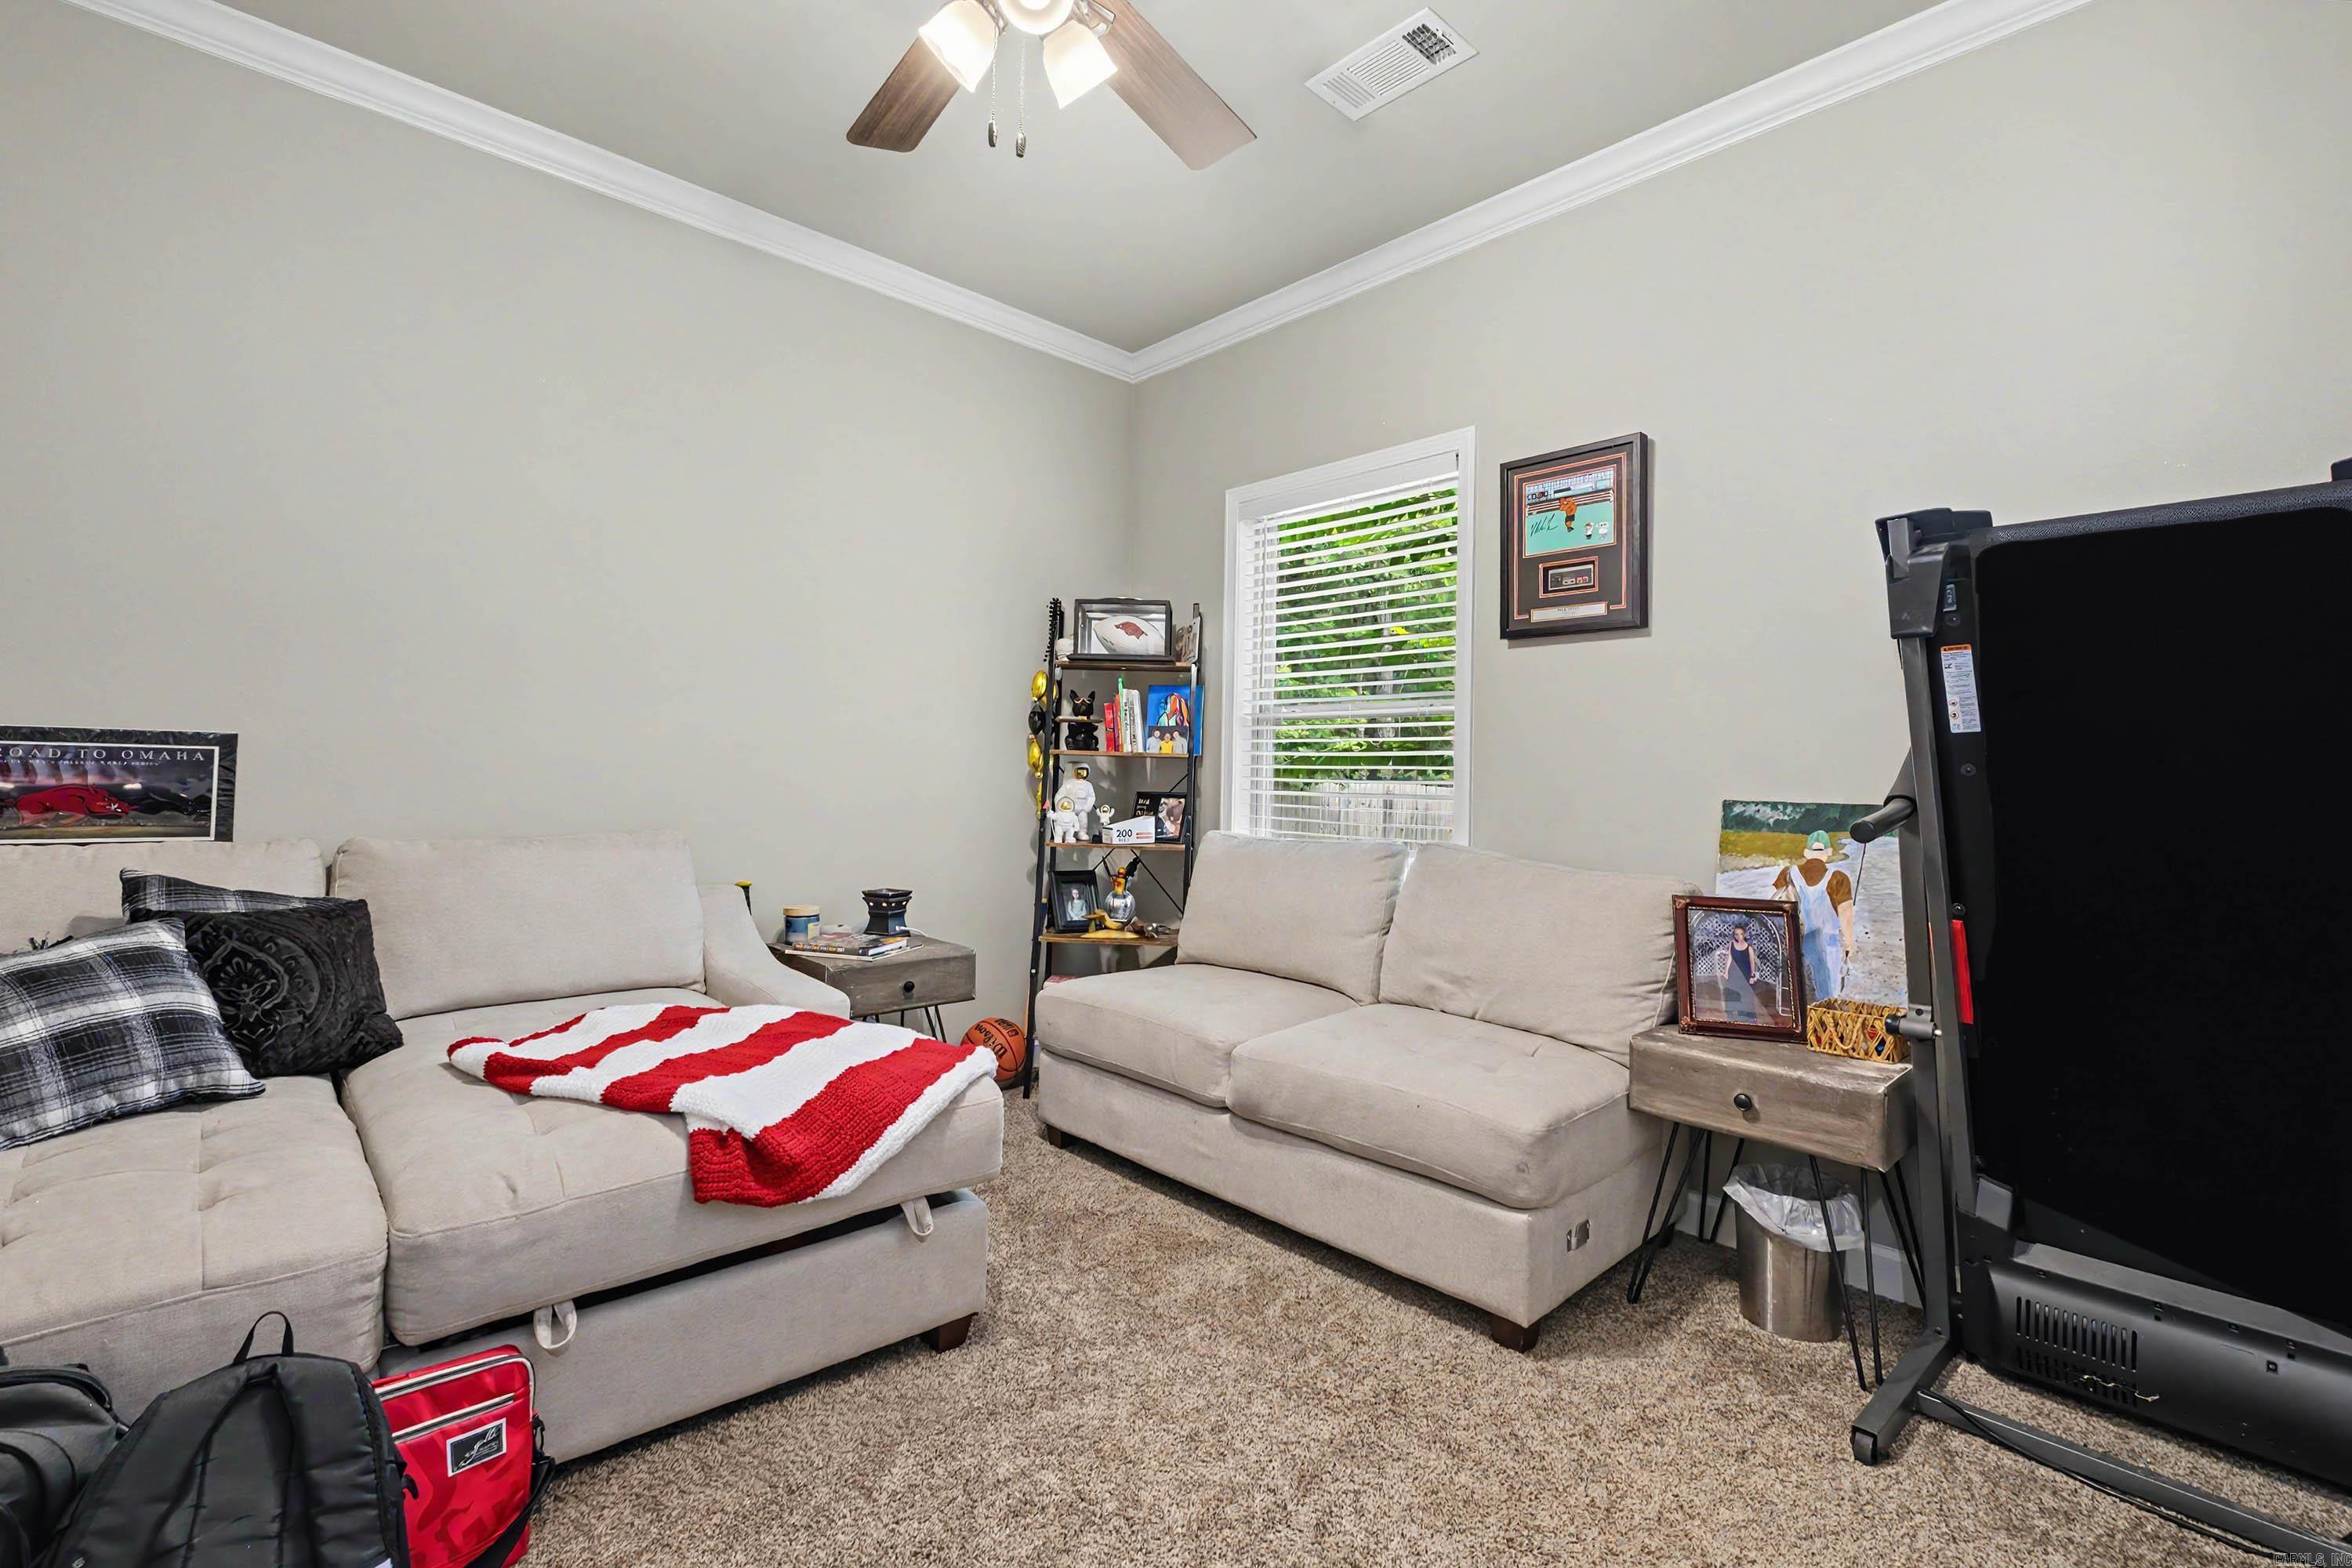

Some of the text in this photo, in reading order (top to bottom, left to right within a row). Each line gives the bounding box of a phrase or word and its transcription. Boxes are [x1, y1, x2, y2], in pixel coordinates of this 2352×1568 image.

[0, 747, 205, 760] OAD TO OMAHA
[1116, 829, 1133, 838] 200
